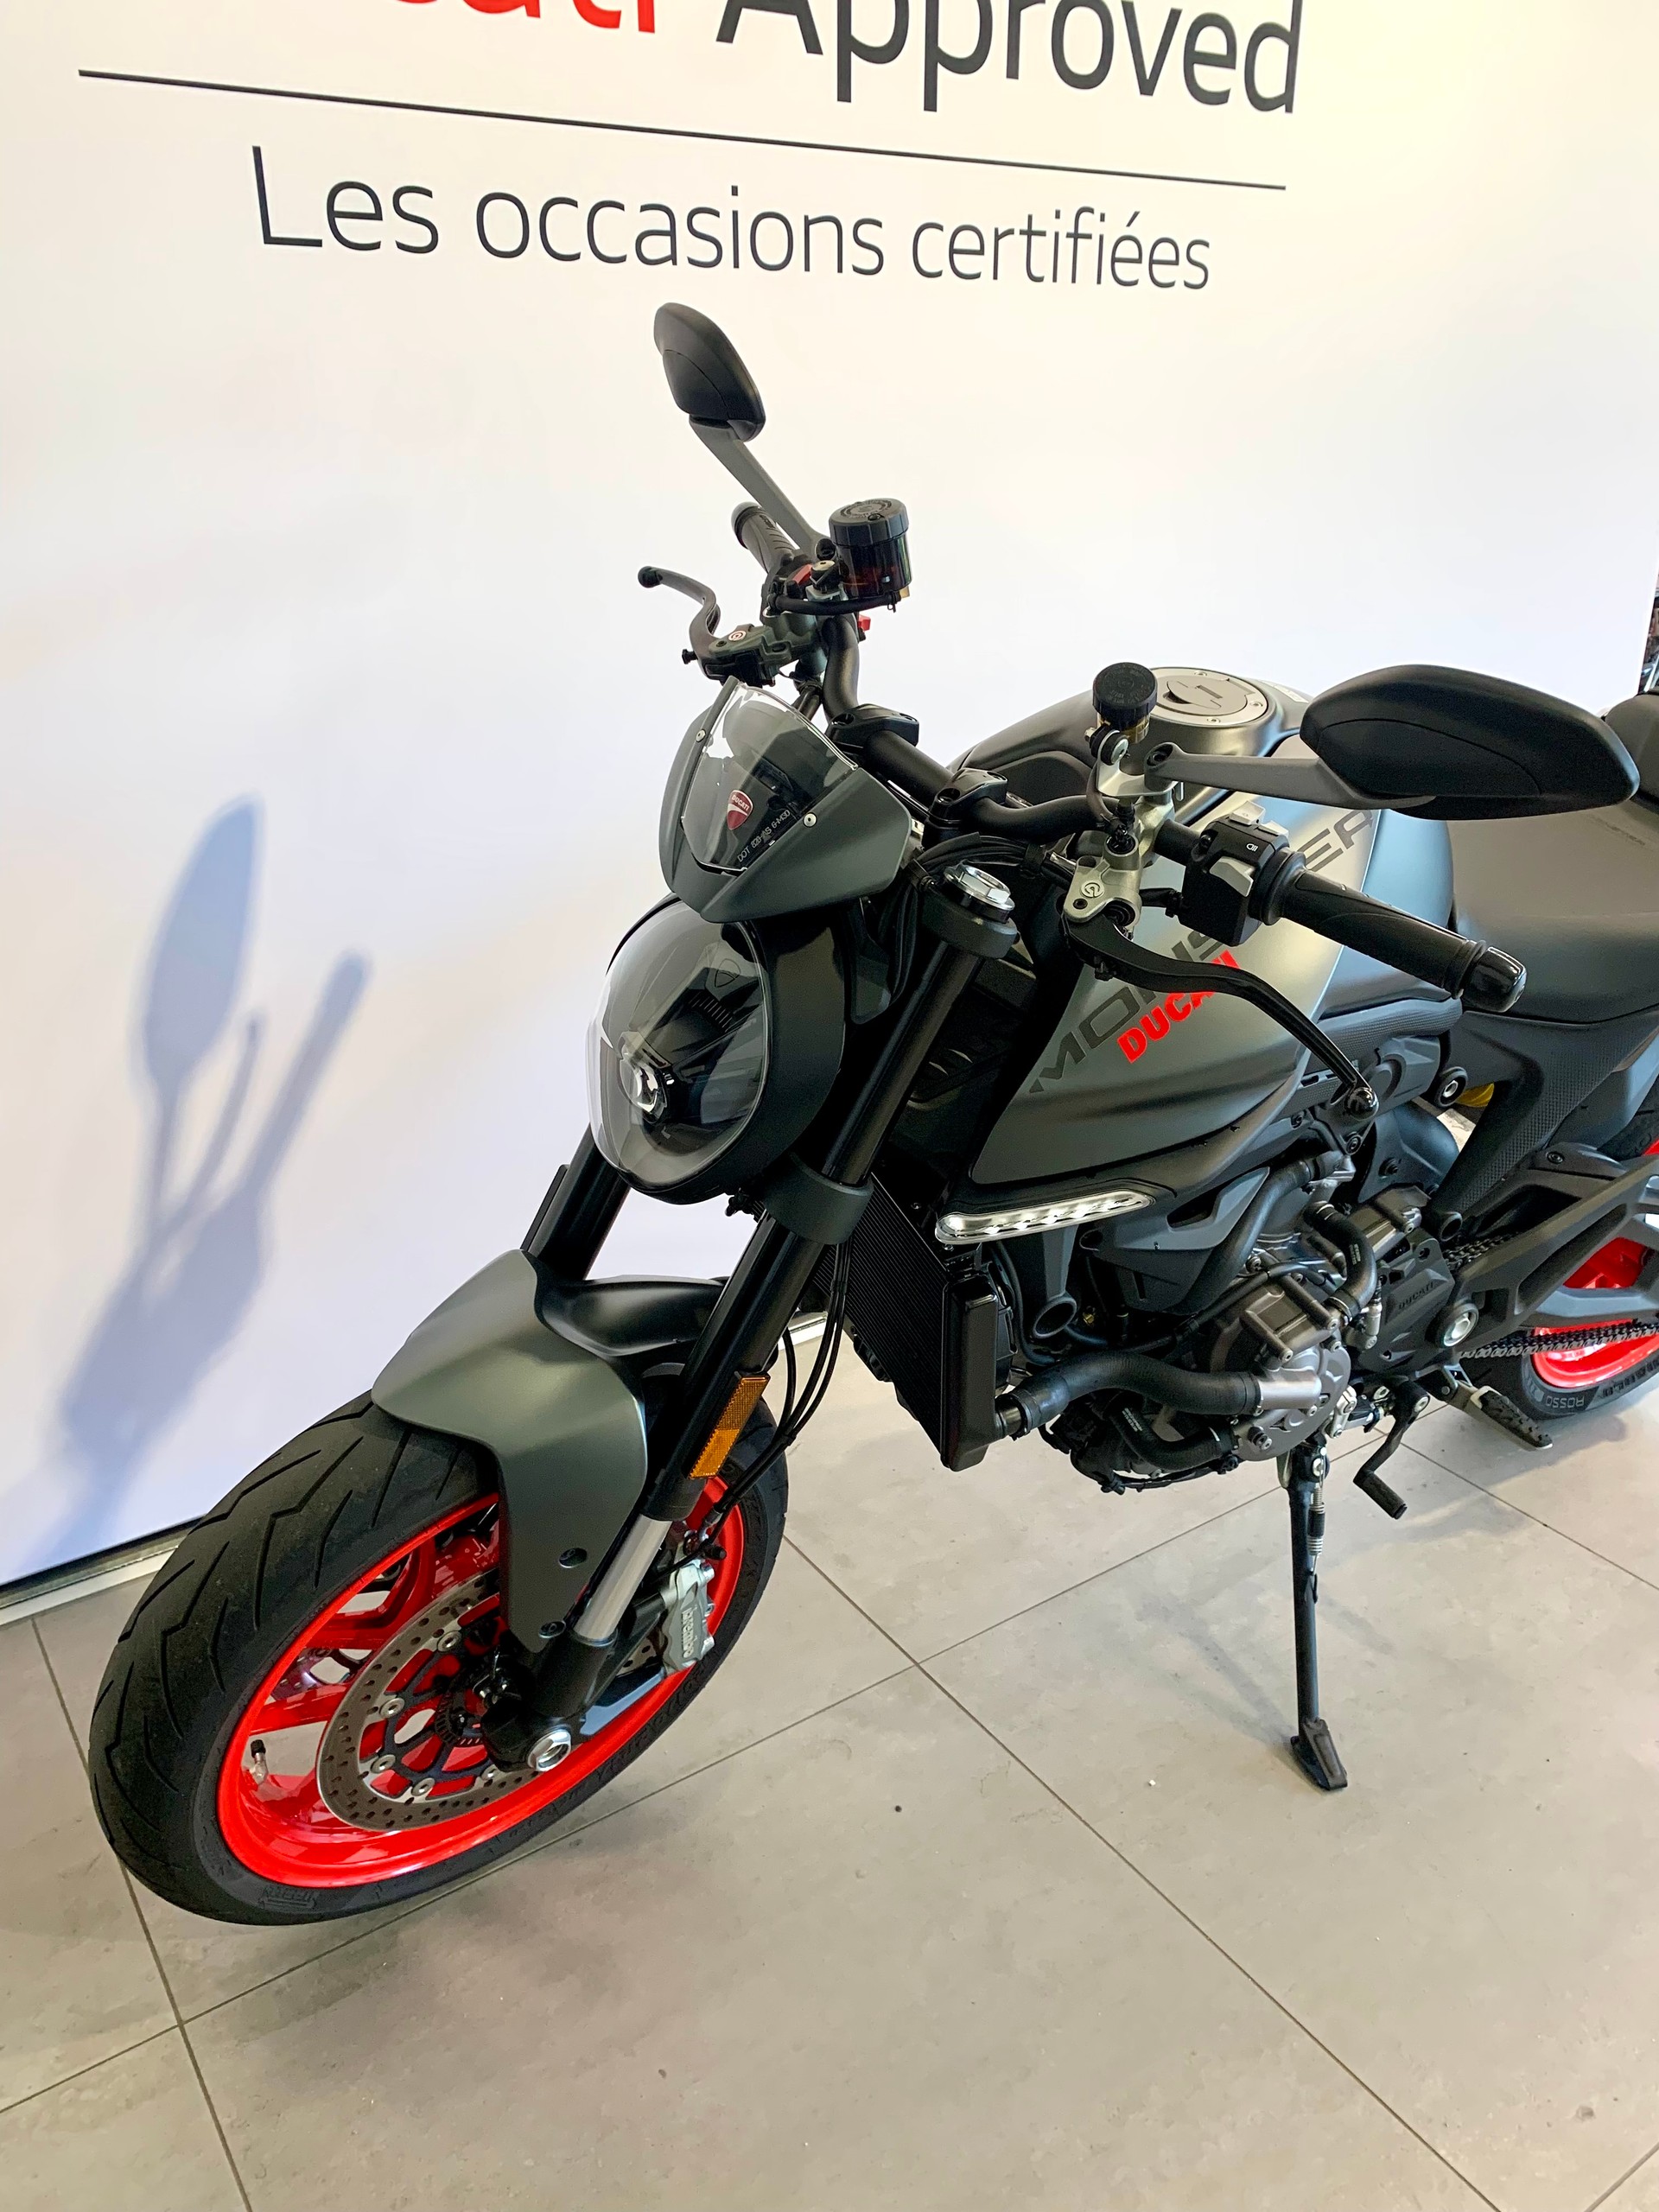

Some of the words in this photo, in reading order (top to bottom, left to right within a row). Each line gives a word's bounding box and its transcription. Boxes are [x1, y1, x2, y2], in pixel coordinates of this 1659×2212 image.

[251, 145, 439, 254] Les
[476, 185, 884, 276] occasions
[912, 207, 1210, 289] certifiées
[731, 794, 750, 811] DUCATI
[737, 845, 750, 862] DOT
[1545, 1395, 1585, 1409] ROSSO
[681, 1605, 698, 1659] brembo
